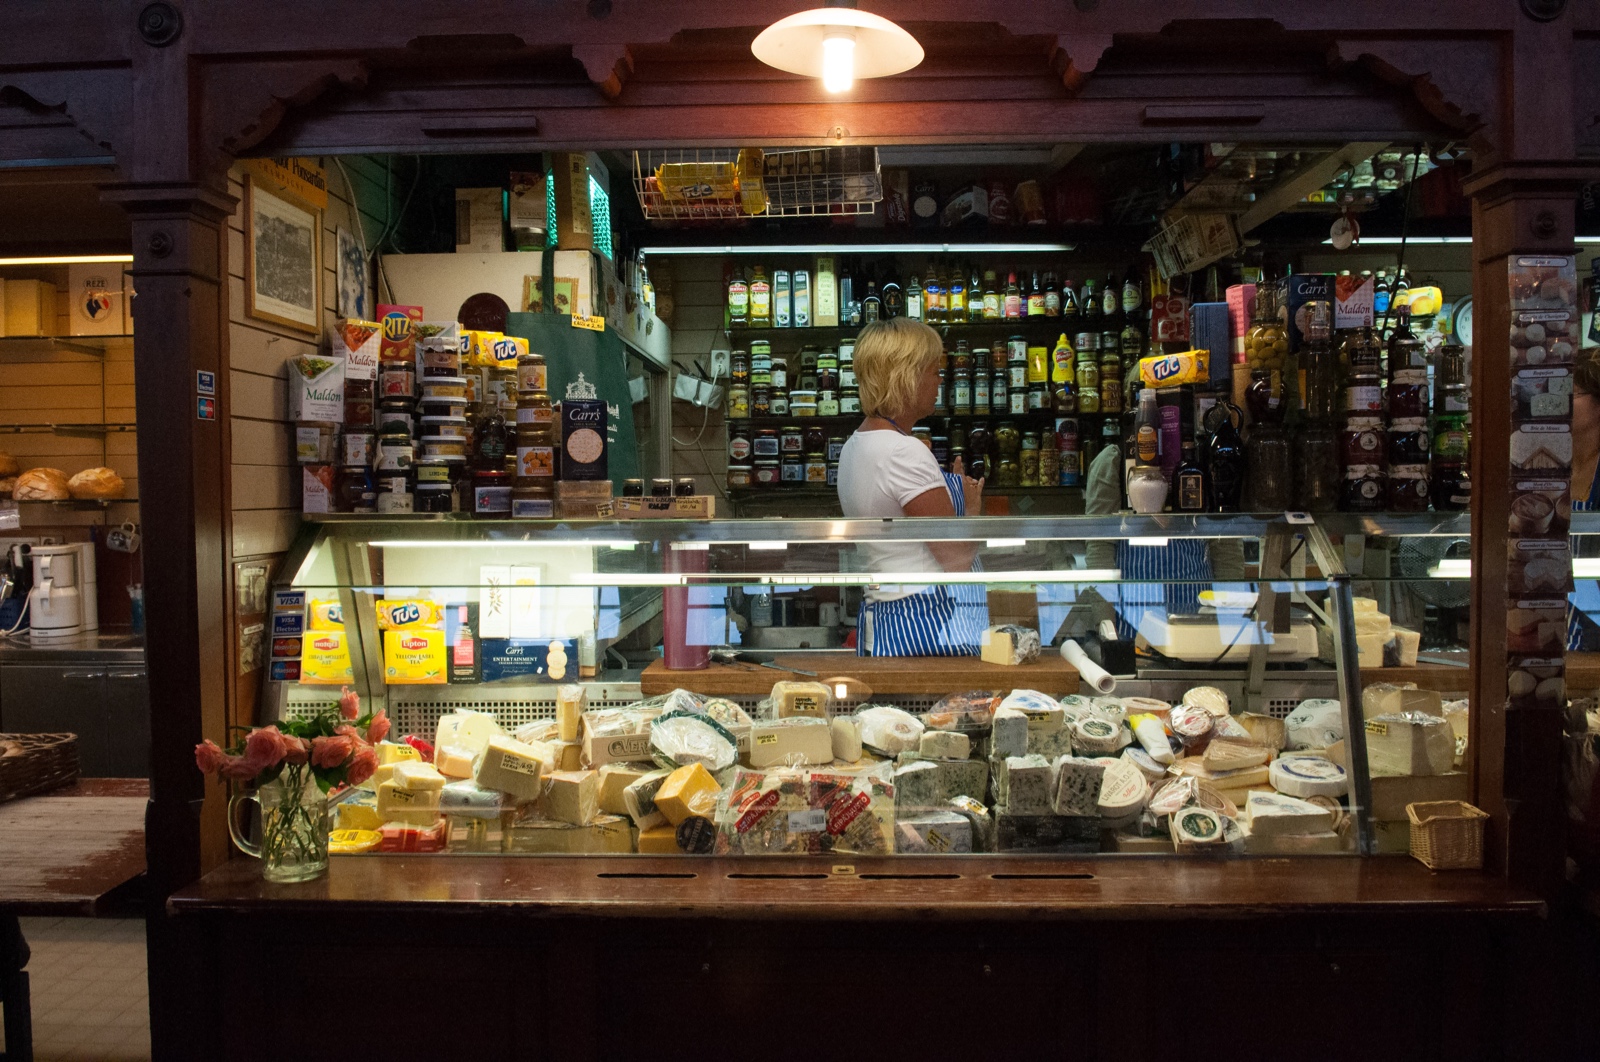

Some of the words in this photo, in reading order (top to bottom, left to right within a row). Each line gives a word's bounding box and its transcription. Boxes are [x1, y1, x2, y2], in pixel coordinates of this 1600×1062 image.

[1297, 282, 1328, 295] Carr's
[1338, 303, 1371, 315] Maldon
[382, 316, 410, 340] RITZ
[495, 340, 517, 359] TUC
[349, 354, 376, 367] Maldon
[1154, 358, 1180, 379] TUC
[306, 387, 341, 403] Maldon
[569, 408, 601, 421] Carr's
[280, 598, 300, 606] VISA
[394, 605, 419, 623] TUC
[274, 643, 301, 651] MasterCard
[403, 640, 427, 649] Lipton
[505, 646, 524, 655] Carr's
[1102, 784, 1122, 802] LIVAROT
[1121, 771, 1135, 786] A.O.C.
